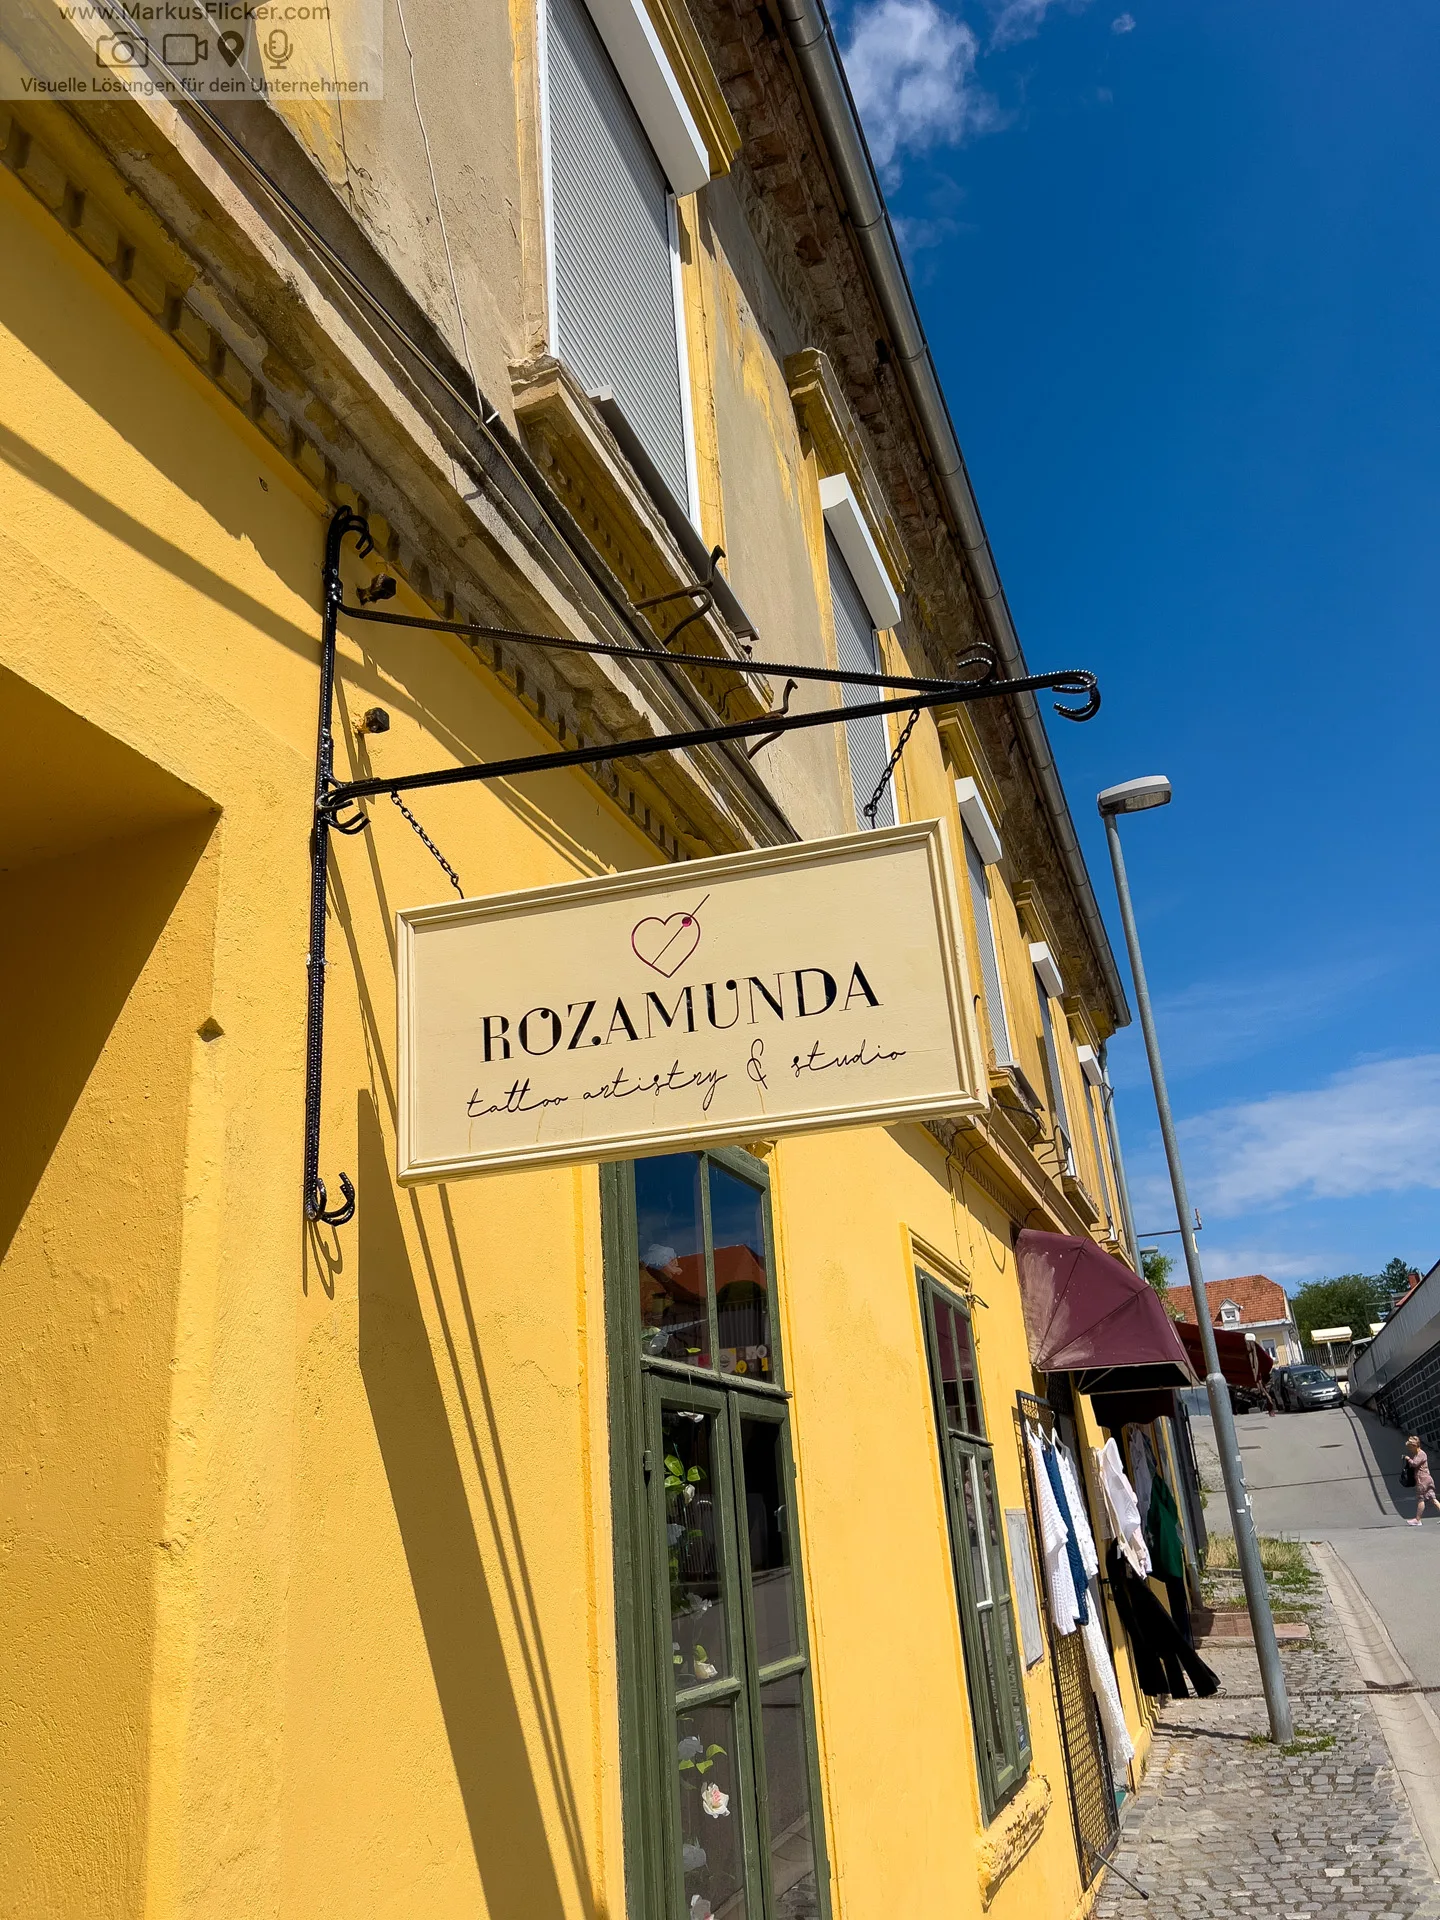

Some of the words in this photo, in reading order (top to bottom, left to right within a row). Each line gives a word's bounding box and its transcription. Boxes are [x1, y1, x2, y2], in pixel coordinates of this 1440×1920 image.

[480, 961, 884, 1063] ROZAMUNDA
[466, 1078, 568, 1118] tattoo
[582, 1059, 728, 1111] artistry
[746, 1038, 768, 1089] &
[791, 1039, 907, 1079] studio
